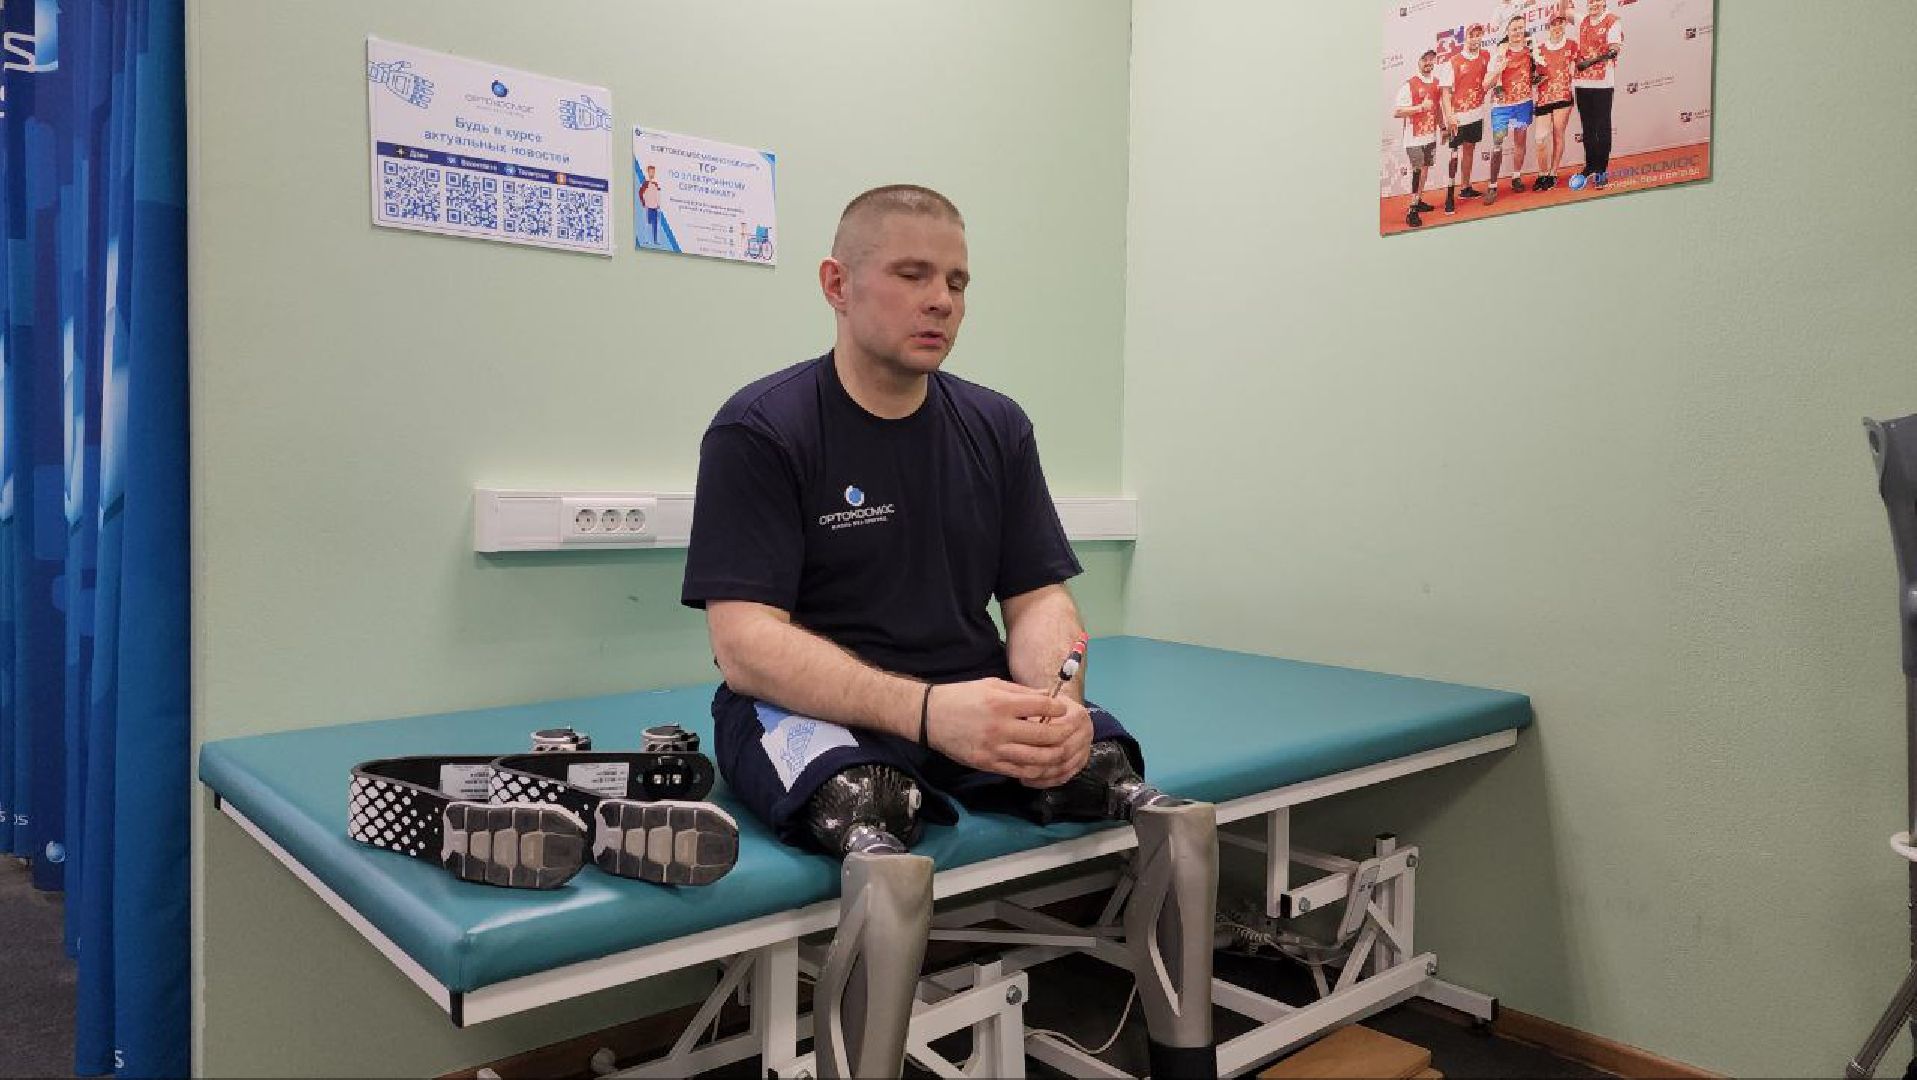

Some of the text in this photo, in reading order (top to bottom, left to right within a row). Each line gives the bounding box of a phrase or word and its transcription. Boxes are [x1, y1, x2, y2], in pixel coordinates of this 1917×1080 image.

[455, 117, 543, 143] Будь в курсе
[424, 131, 570, 163] актуальных новостей
[699, 162, 718, 174] ТСР
[678, 181, 736, 198] СЕРТИФИКАТУ
[818, 503, 896, 526] ОРТОКОСМОС
